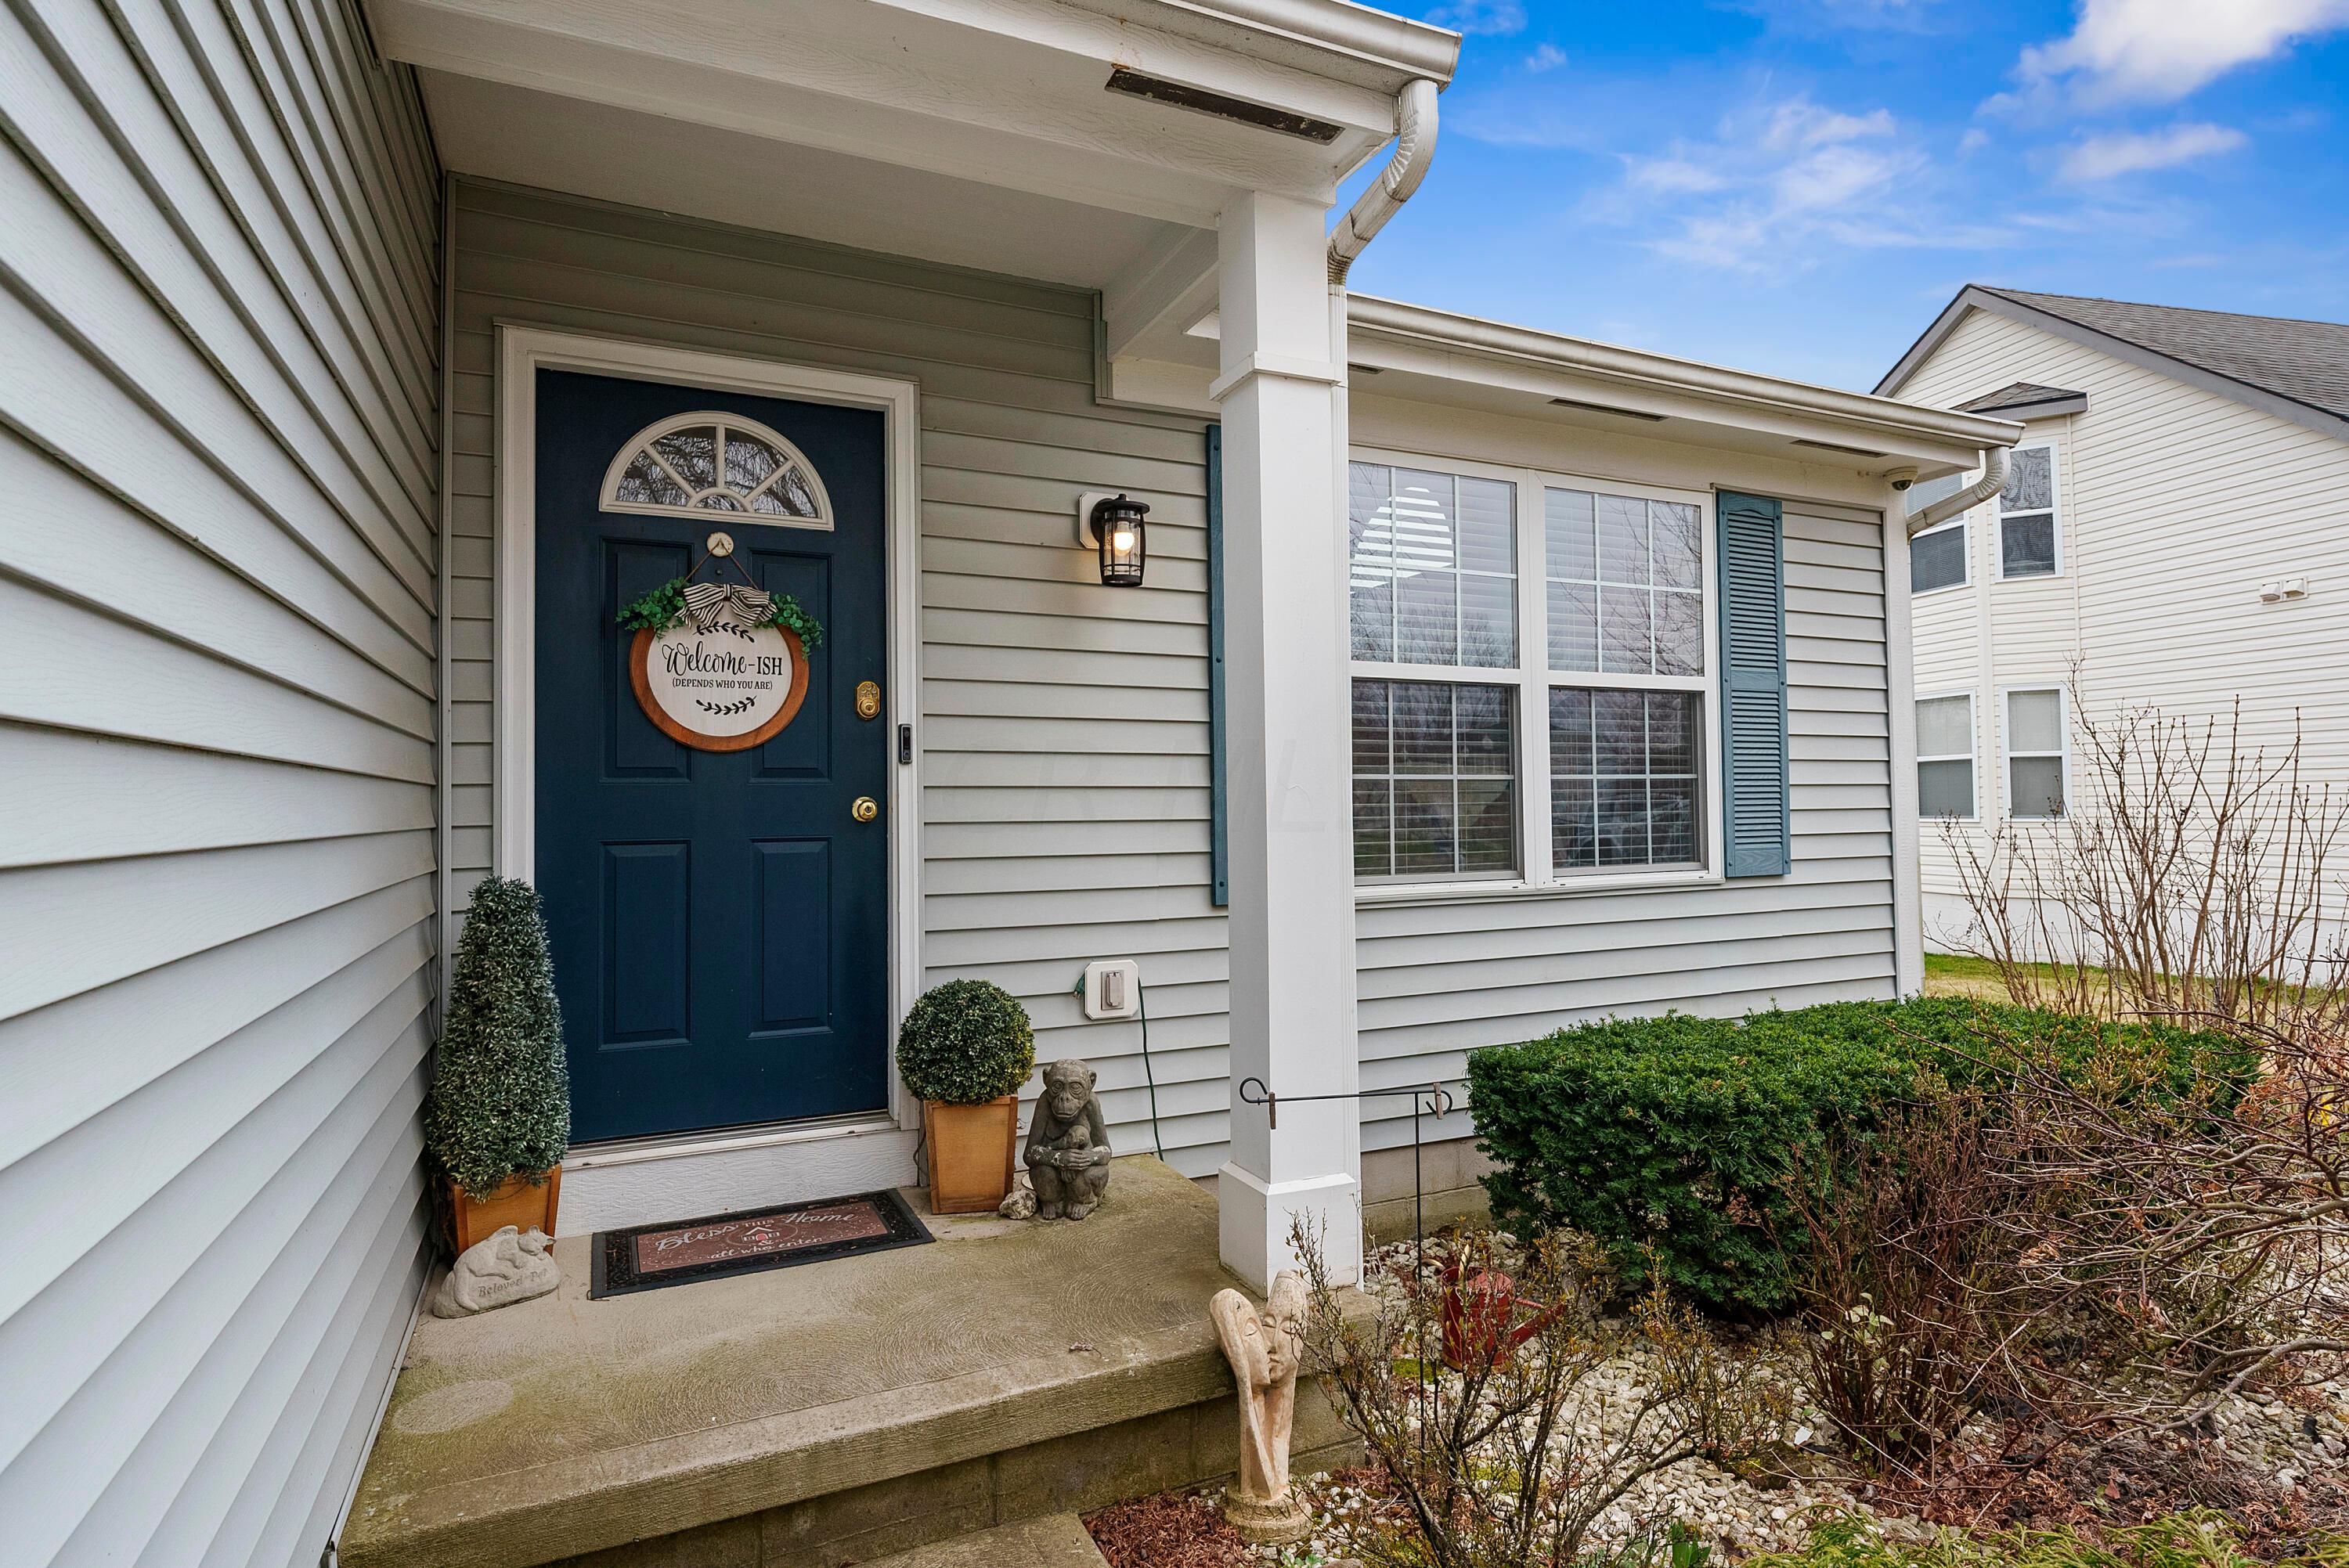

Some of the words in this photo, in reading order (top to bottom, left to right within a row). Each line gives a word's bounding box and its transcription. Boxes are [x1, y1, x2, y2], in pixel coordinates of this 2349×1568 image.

[662, 640, 783, 676] Welcome-ISH
[672, 676, 714, 689] (DEPENDS
[716, 679, 735, 689] WHO
[737, 679, 752, 690] YOU
[754, 680, 773, 690] ARE)
[655, 1225, 738, 1251] Bless
[781, 1212, 857, 1224] Home
[711, 1249, 738, 1259] all
[741, 1245, 774, 1254] who
[778, 1237, 823, 1249] enter
[478, 1277, 522, 1297] Beloved
[529, 1268, 548, 1282] Pet
